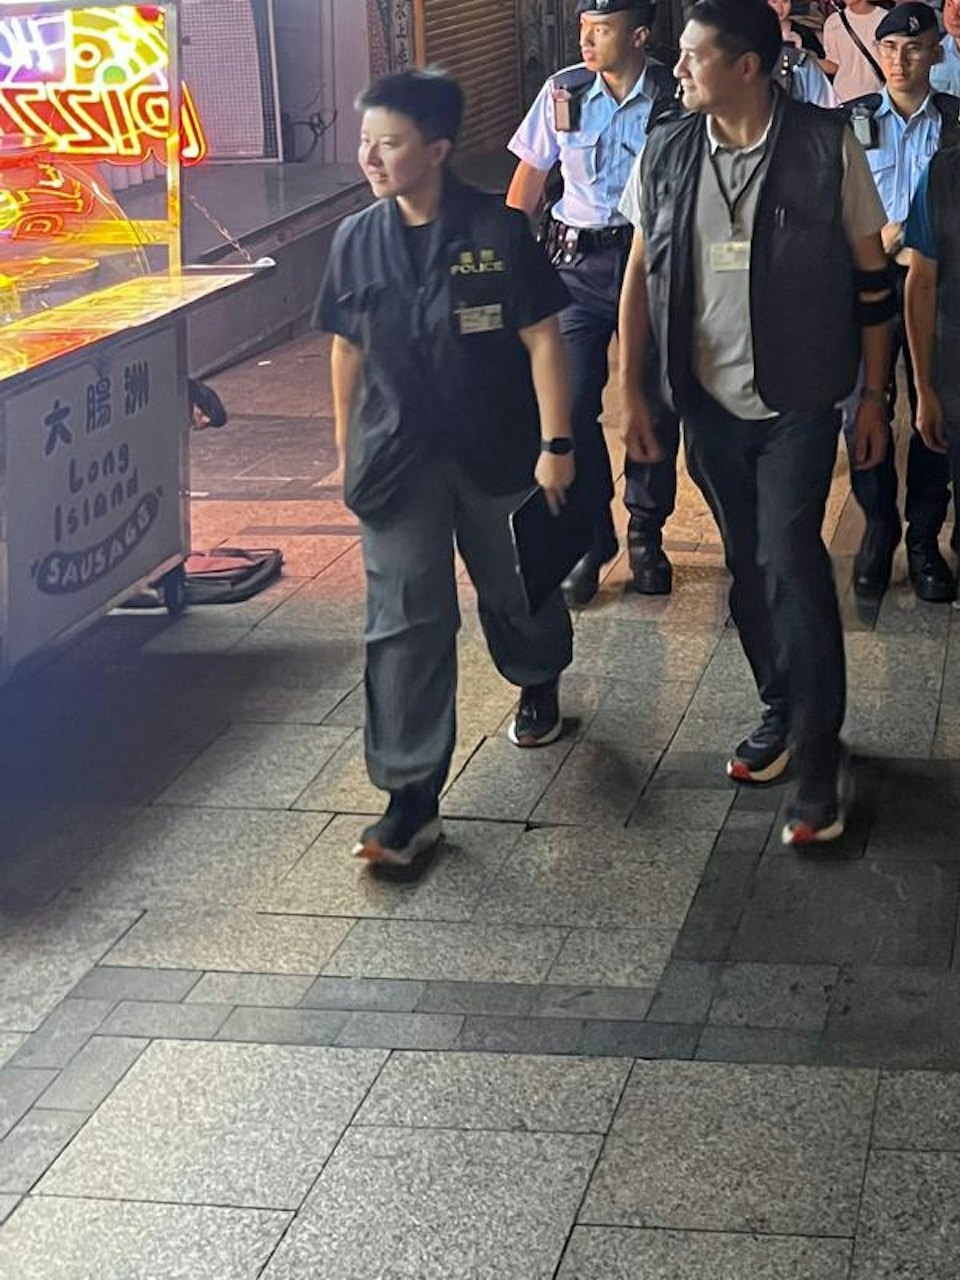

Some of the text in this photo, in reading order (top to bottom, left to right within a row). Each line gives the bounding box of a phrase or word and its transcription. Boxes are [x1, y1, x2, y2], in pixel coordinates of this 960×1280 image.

[450, 261, 505, 276] POLICE
[45, 363, 148, 456] 大腸洲
[69, 443, 129, 494] Long
[46, 500, 152, 586] SAUSAGE
[54, 469, 138, 543] Island
